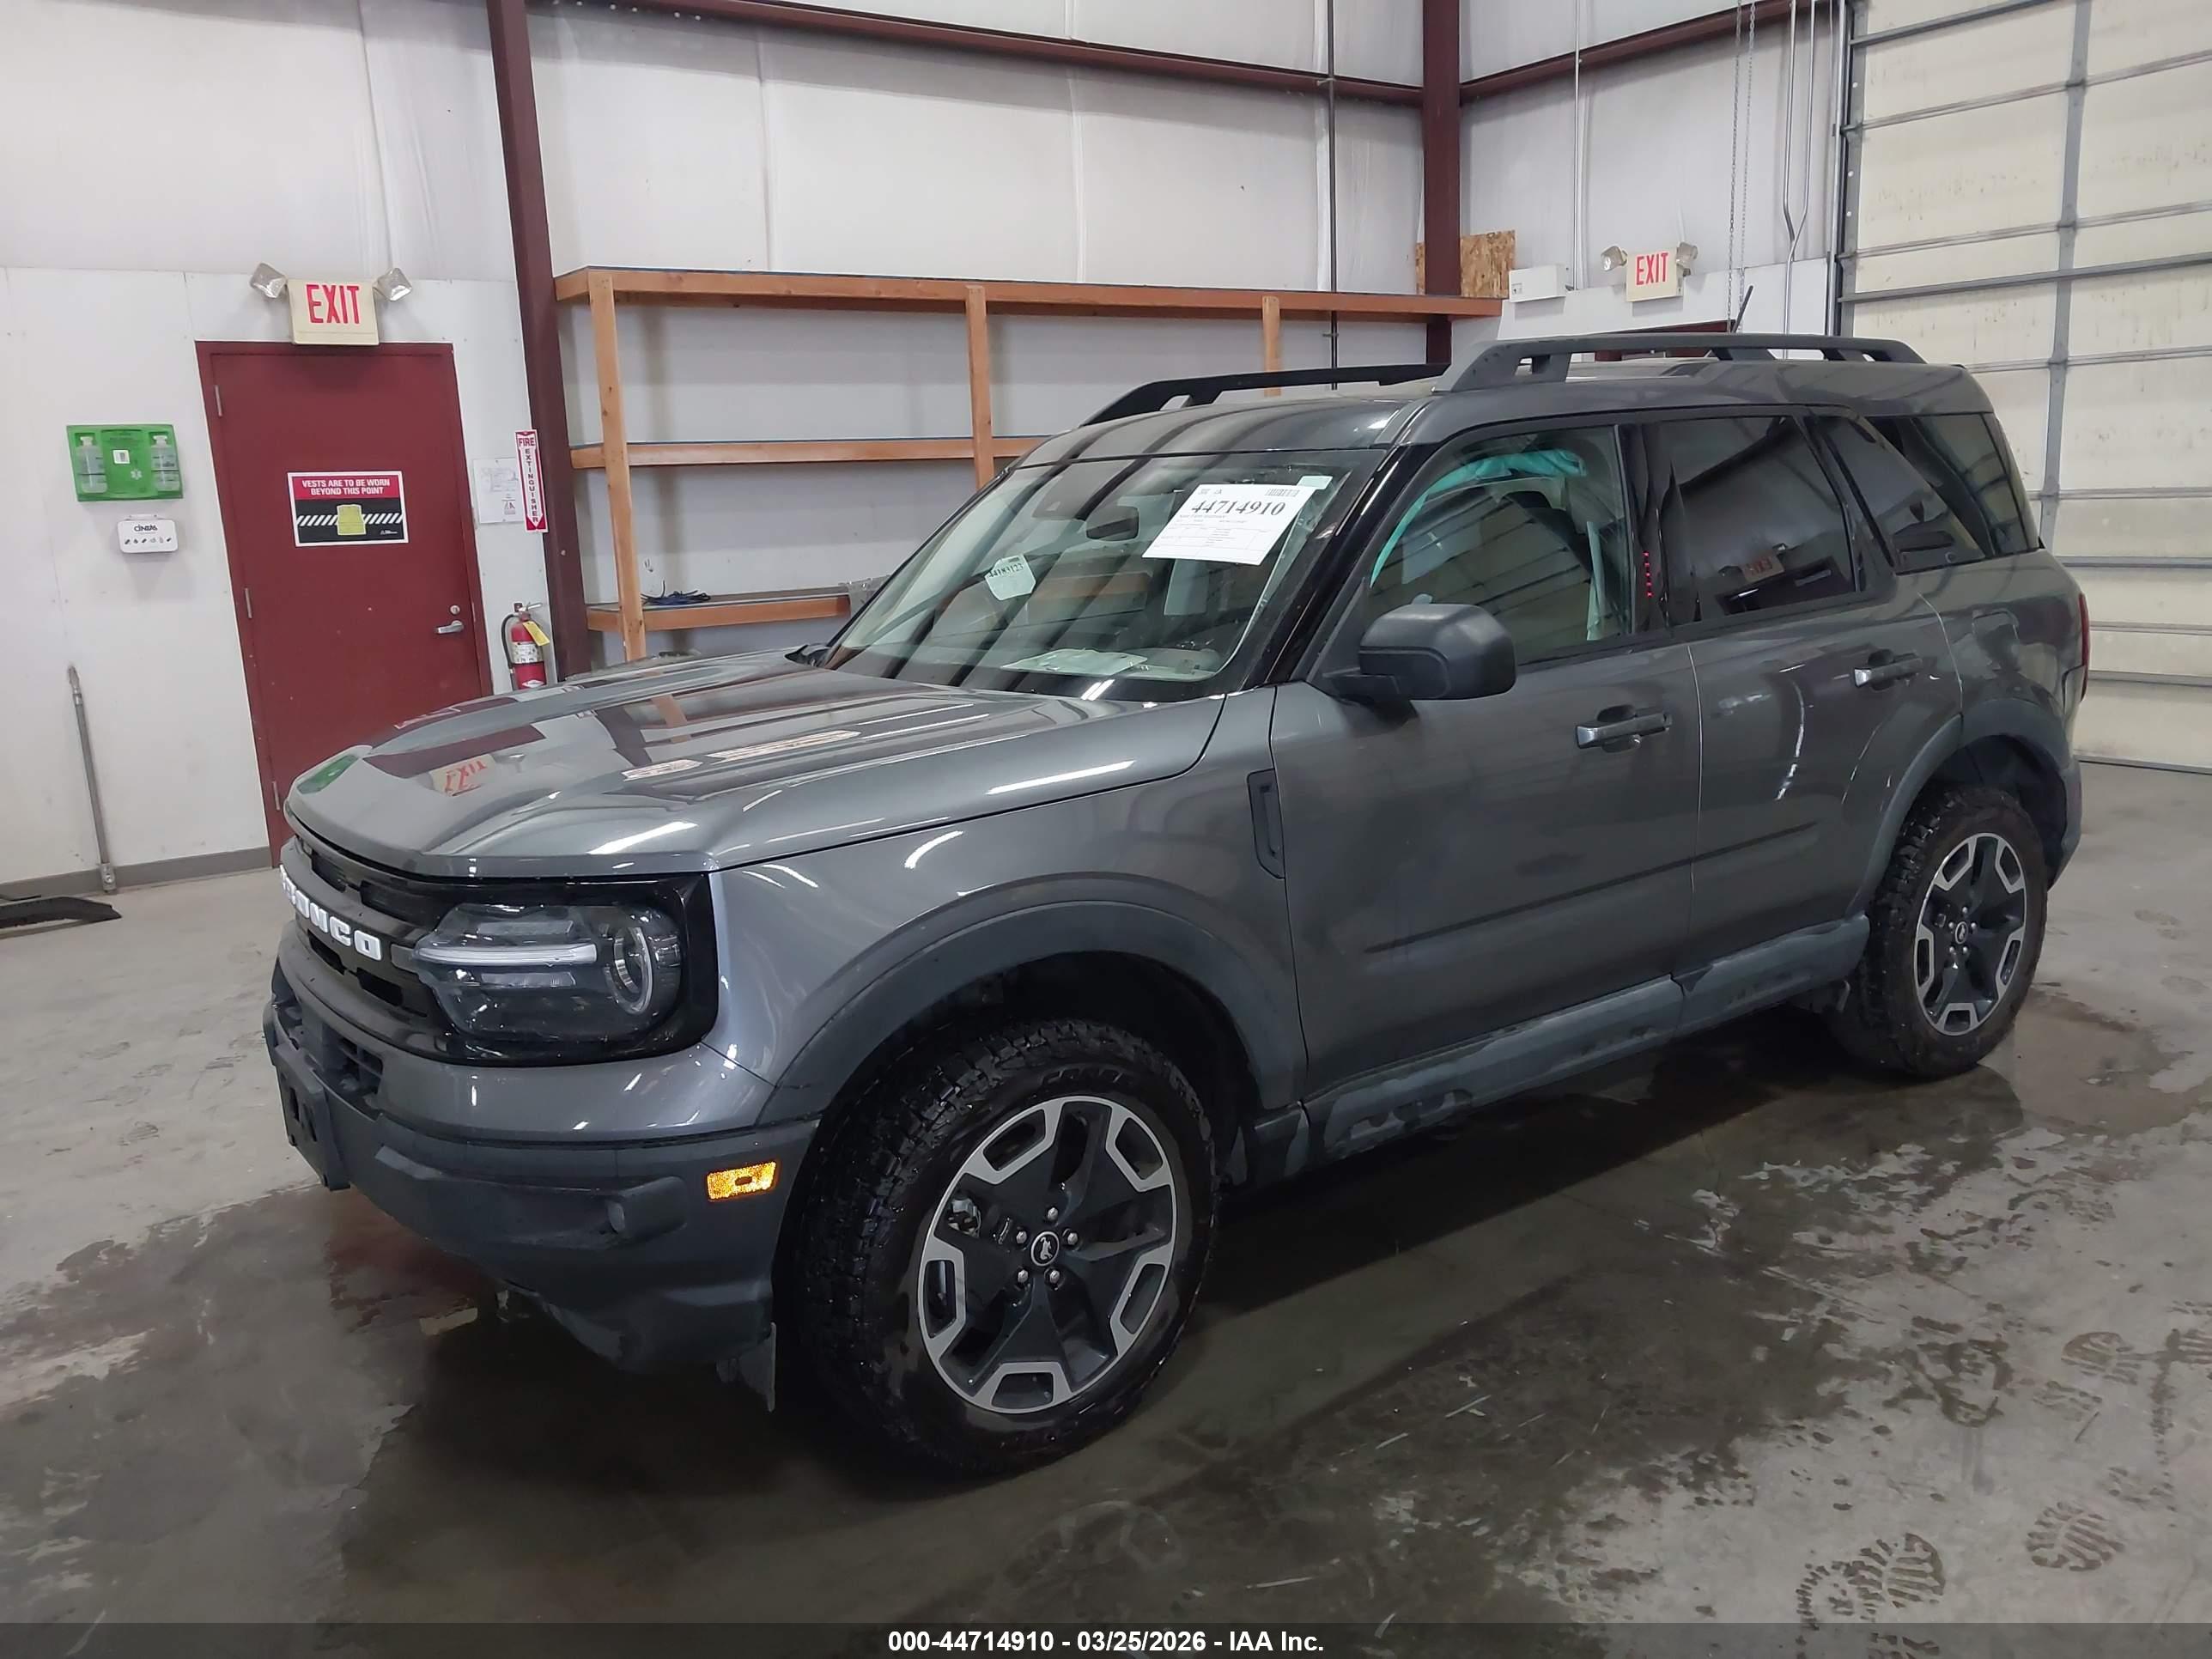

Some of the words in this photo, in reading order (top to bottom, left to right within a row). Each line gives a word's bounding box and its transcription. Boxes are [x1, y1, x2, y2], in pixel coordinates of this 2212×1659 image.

[1636, 252, 1668, 286] EXIT
[306, 284, 360, 324] EXIT
[518, 437, 535, 447] FIRE
[301, 479, 326, 488] VESTS
[328, 479, 343, 488] ARE
[356, 478, 366, 487] BE
[362, 486, 384, 495] POINT
[525, 448, 538, 523] EXTINGUISHER
[1191, 500, 1286, 516] 44714910
